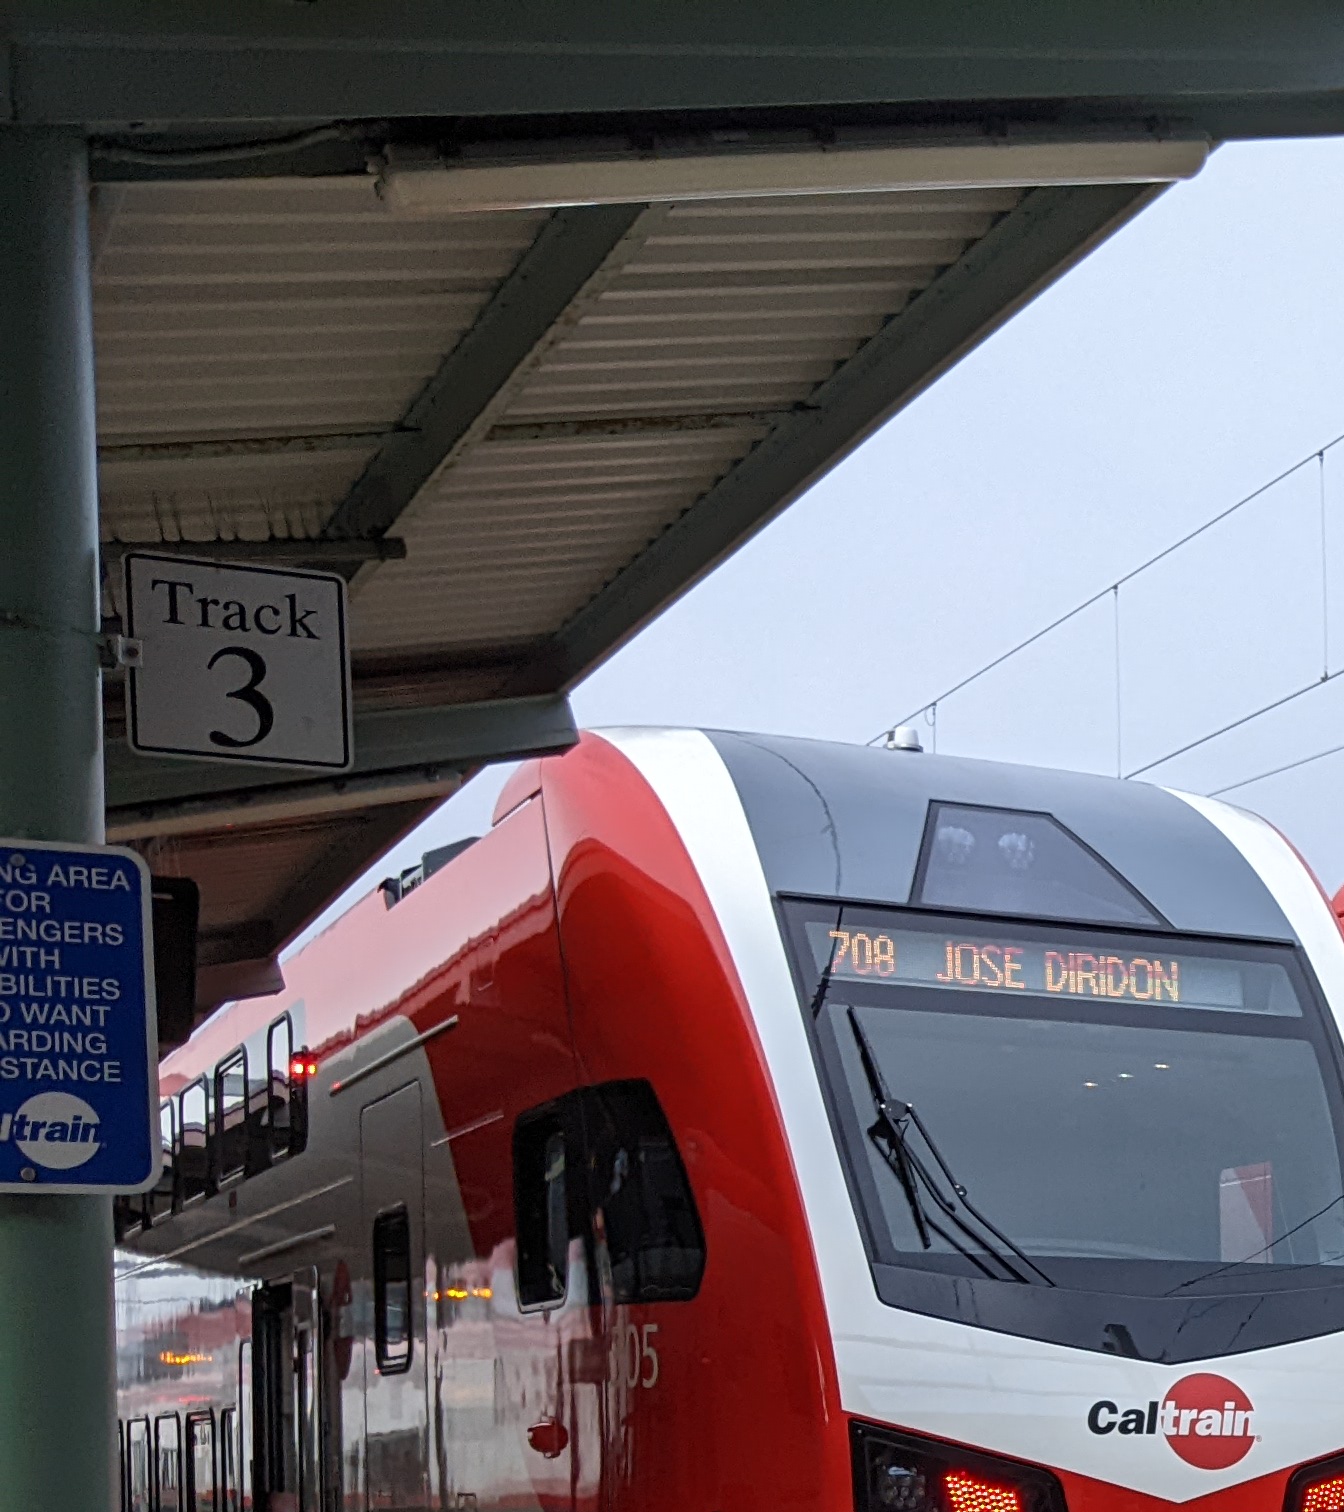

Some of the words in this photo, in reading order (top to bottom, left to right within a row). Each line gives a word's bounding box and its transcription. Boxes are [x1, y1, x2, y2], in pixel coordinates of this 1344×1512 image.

[151, 579, 320, 640] Track
[207, 646, 274, 748] 3
[47, 863, 130, 891] AREA
[0, 917, 124, 946] ENGERS
[829, 930, 894, 977] 708
[937, 941, 1025, 989] JOSE
[1045, 951, 1180, 1001] DIRIDON
[0, 973, 120, 1000] BILITIES
[20, 1002, 111, 1027] WANT
[0, 1057, 122, 1082] STANCE
[1087, 1400, 1257, 1436] Caltrain
